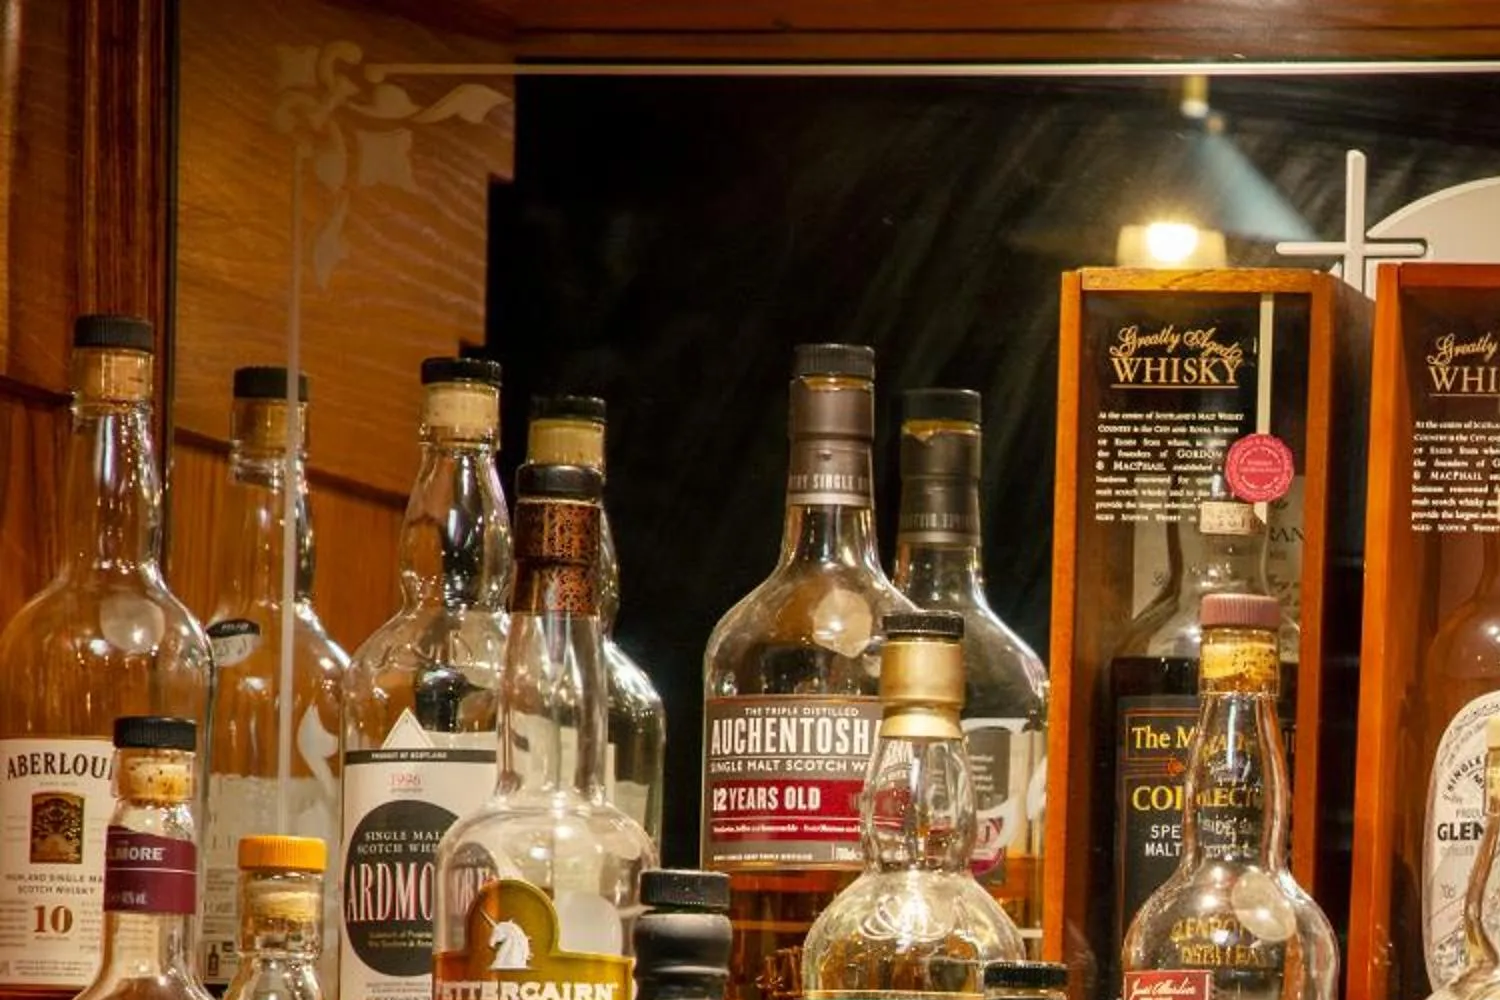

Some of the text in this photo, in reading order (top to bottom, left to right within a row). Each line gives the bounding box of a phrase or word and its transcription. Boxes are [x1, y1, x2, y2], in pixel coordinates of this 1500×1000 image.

[1110, 357, 1244, 383] WHISKY
[746, 707, 859, 716] THE TRIPLE DISTILLED
[1132, 726, 1170, 748] The
[747, 760, 780, 771] MALT
[786, 760, 847, 772] SCOTCH
[713, 787, 820, 811] 12 YEARS OLD
[365, 831, 407, 841] SINGLE
[357, 843, 402, 853] SCOTCH
[1144, 842, 1182, 856] MALT
[18, 885, 94, 895] SCOTCH WHISKY
[34, 905, 73, 934] 10
